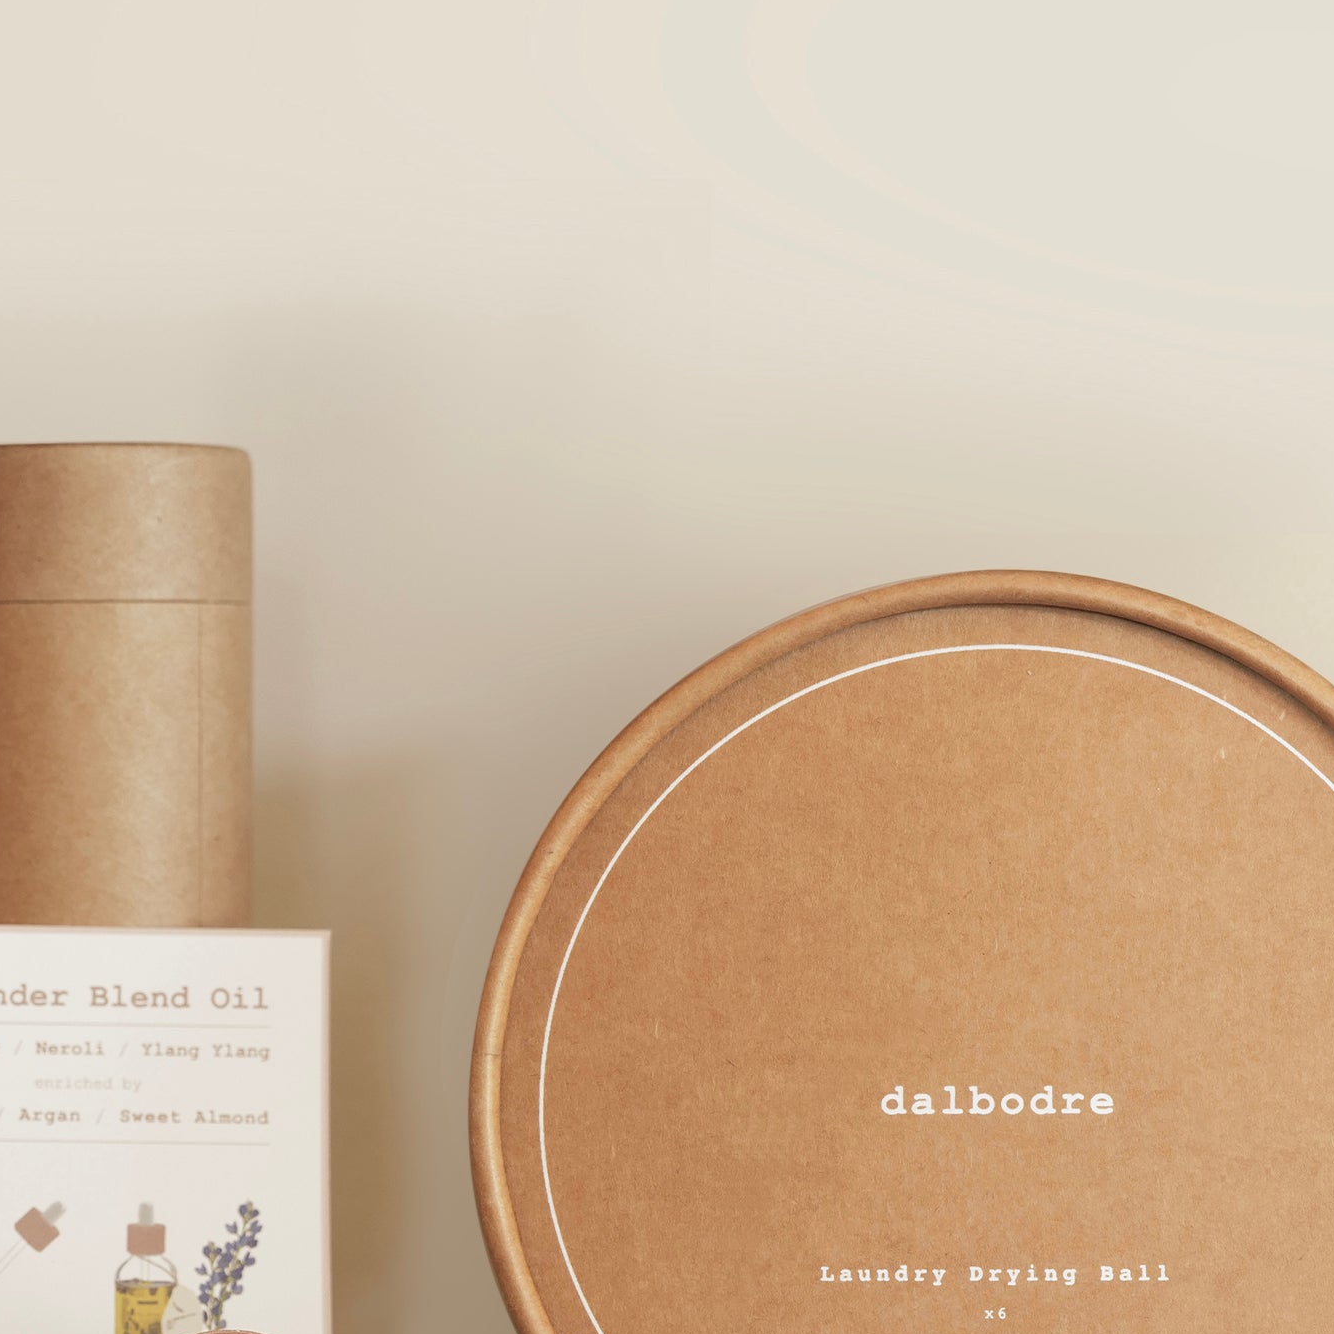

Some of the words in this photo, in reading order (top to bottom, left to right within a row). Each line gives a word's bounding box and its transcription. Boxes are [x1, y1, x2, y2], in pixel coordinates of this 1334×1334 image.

[89, 985, 191, 1009] Blend
[210, 987, 270, 1011] Oil
[35, 1041, 105, 1057] Neroli
[142, 1042, 200, 1061] Ylang
[212, 1043, 271, 1062] Ylang
[34, 1076, 112, 1090] enriched
[122, 1078, 142, 1093] by
[880, 1085, 1115, 1115] dalbodre
[18, 1107, 81, 1125] Argan
[119, 1109, 181, 1125] Sweet
[194, 1110, 269, 1125] Almond
[819, 1265, 947, 1286] Laundry
[968, 1265, 1078, 1286] Drying
[1099, 1264, 1170, 1282] Ball
[984, 1307, 1007, 1320] x6
